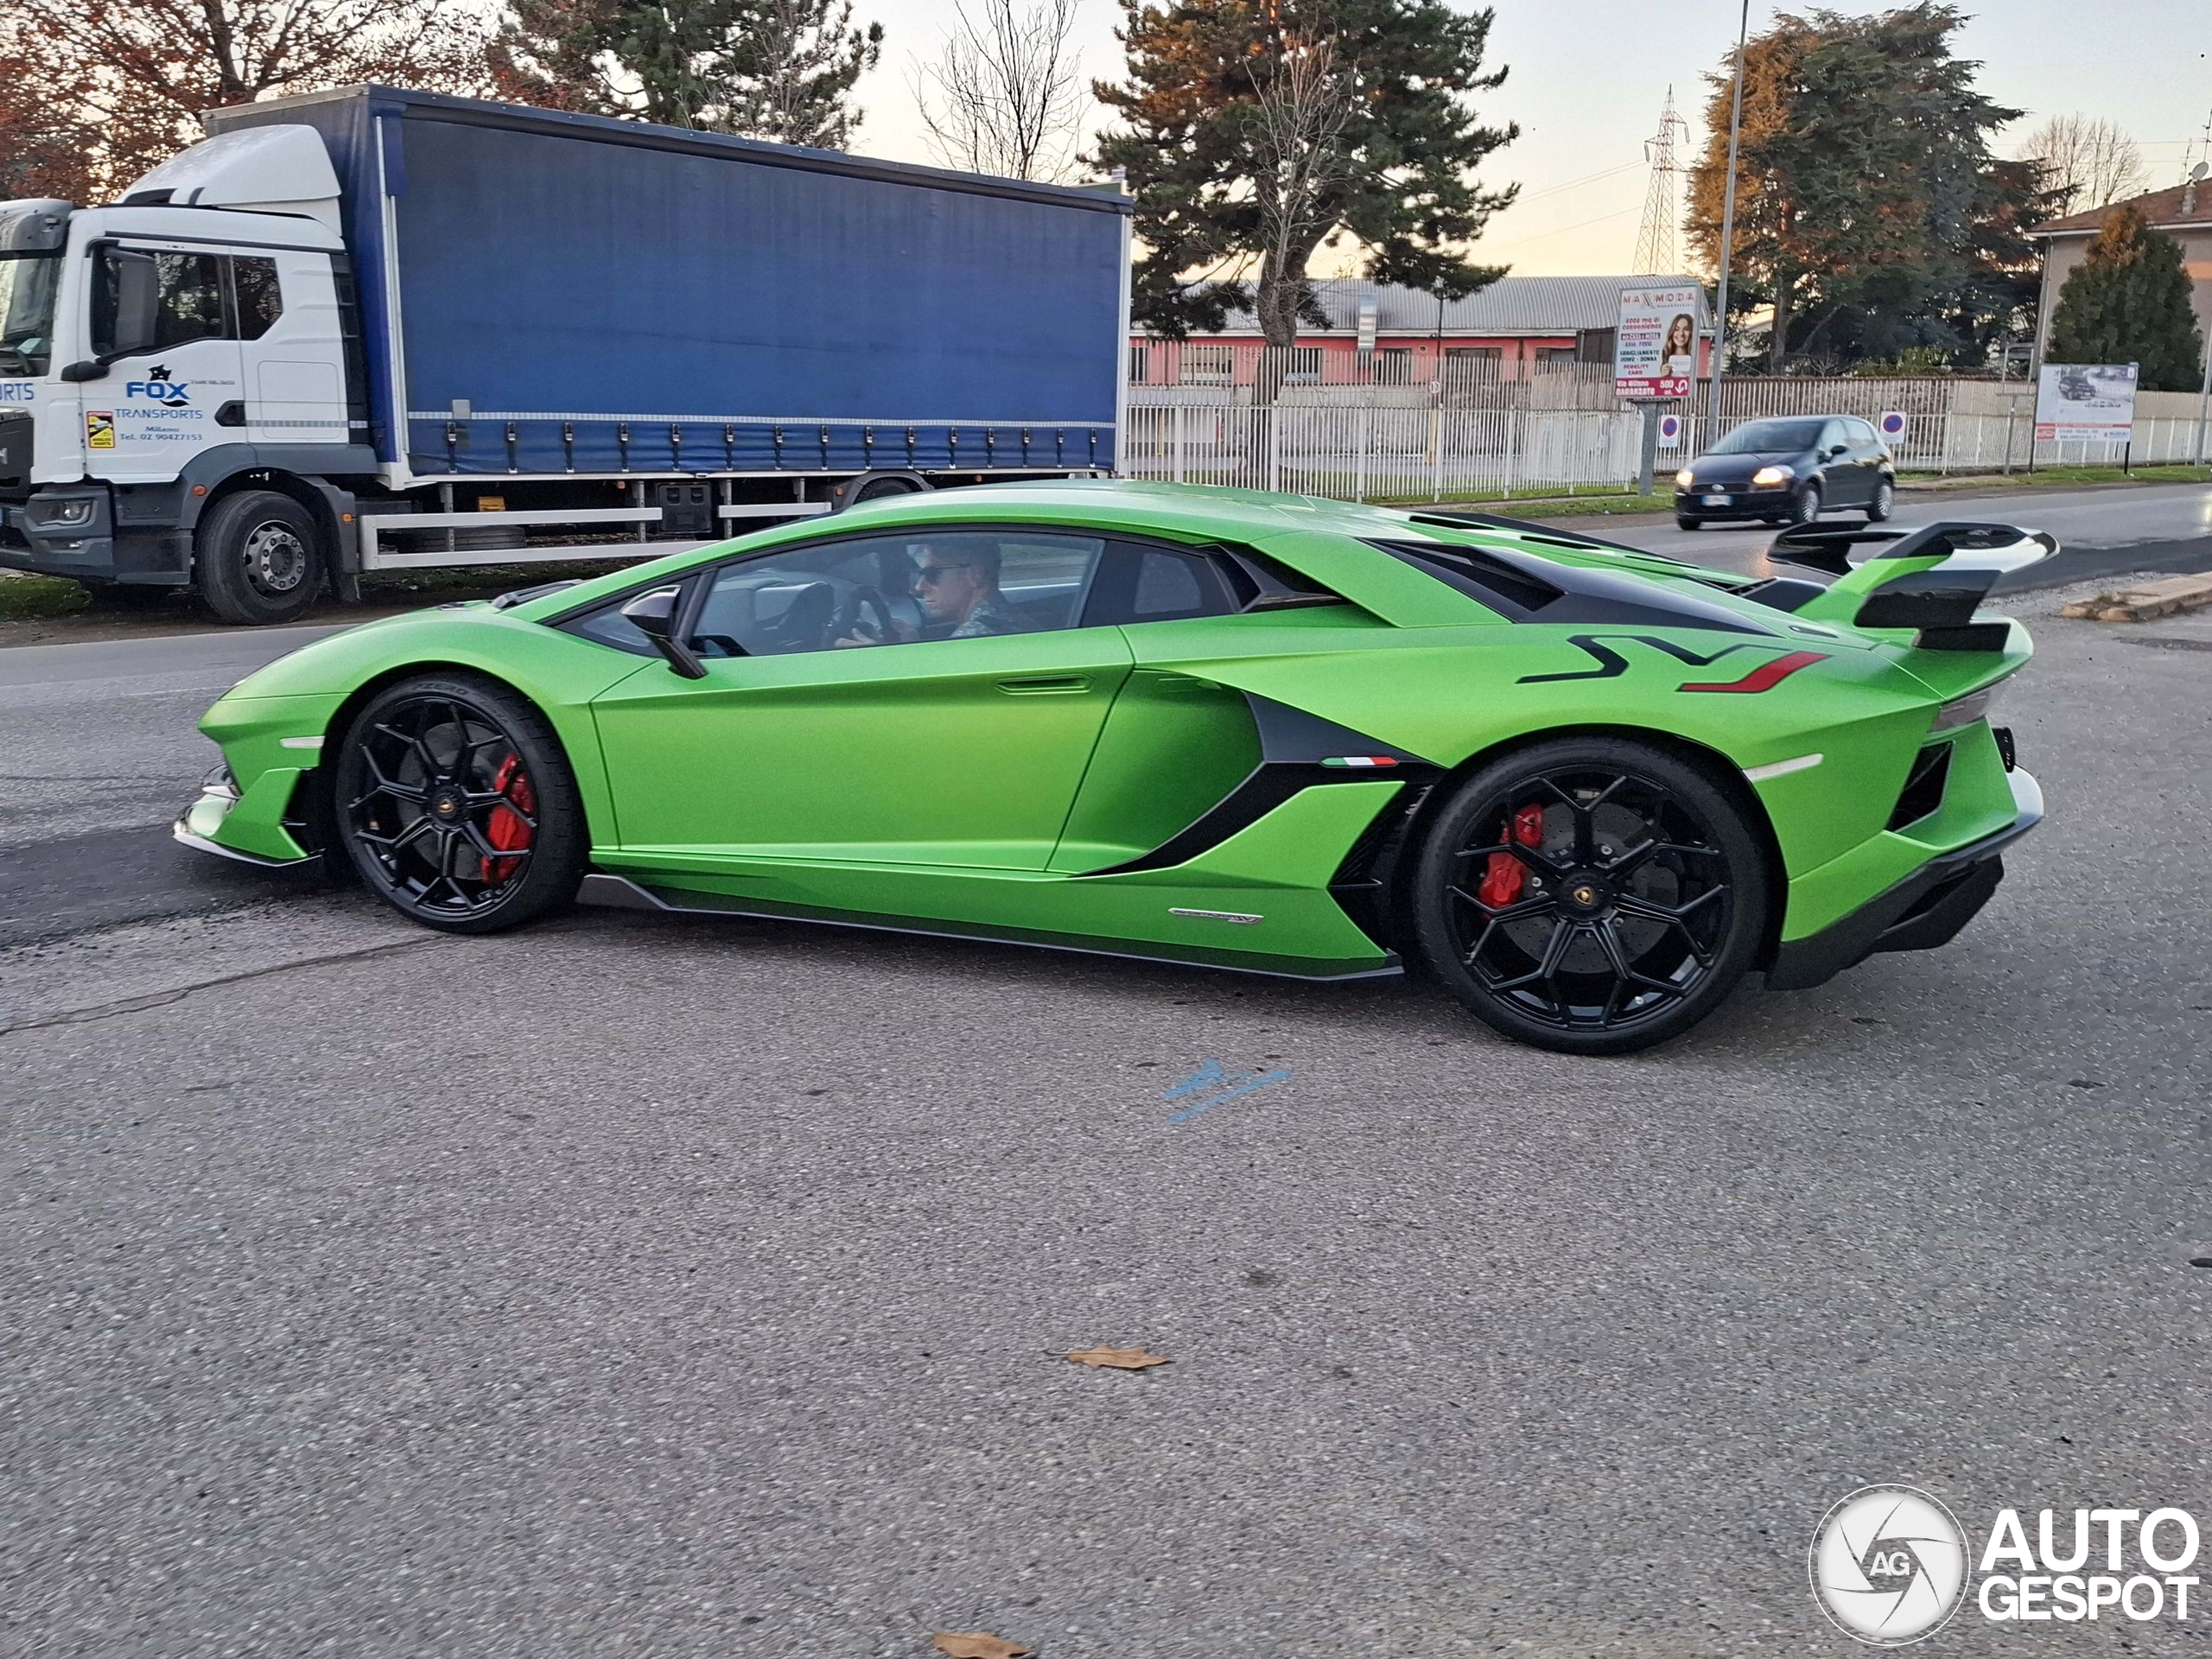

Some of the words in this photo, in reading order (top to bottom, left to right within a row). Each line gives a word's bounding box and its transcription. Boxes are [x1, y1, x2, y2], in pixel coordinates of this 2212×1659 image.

[1656, 293, 1694, 302] MODA
[0, 383, 35, 400] RTS
[126, 381, 191, 399] FOX
[114, 409, 203, 419] TRANSPORTS
